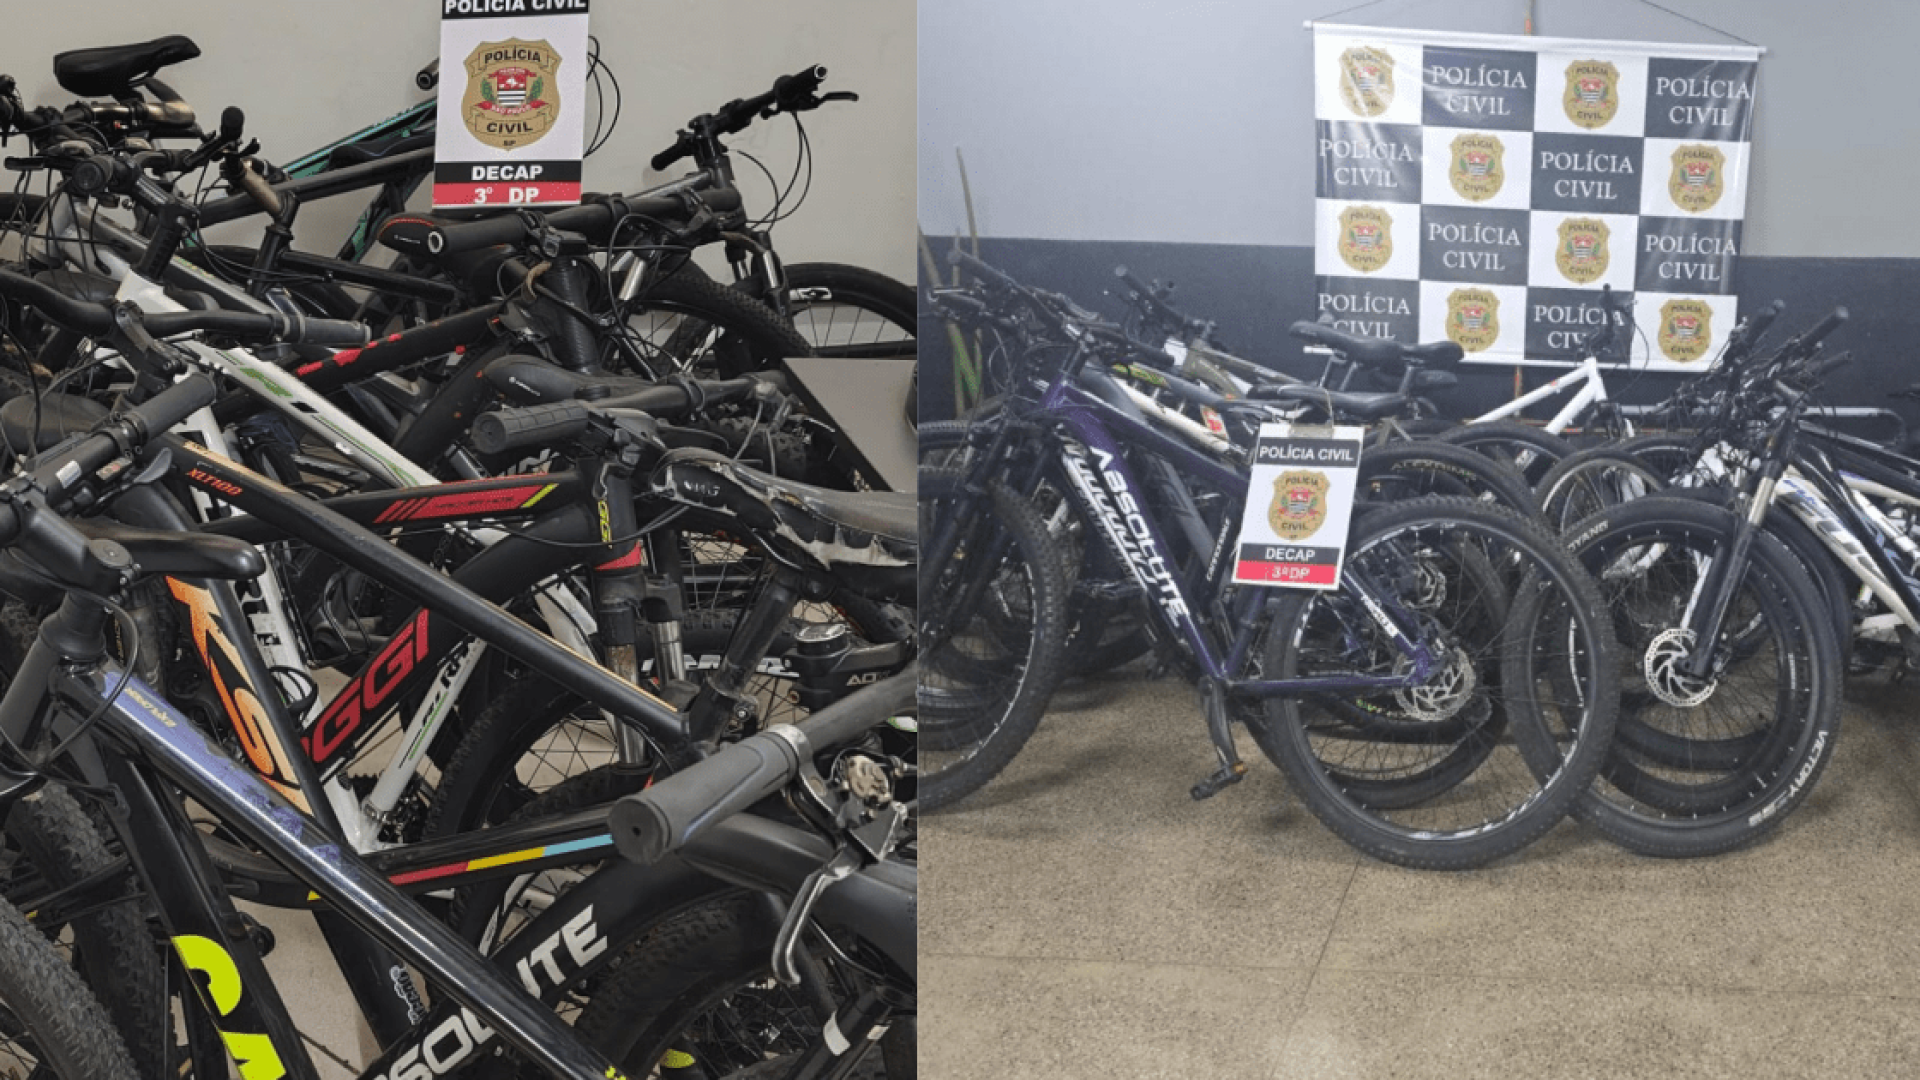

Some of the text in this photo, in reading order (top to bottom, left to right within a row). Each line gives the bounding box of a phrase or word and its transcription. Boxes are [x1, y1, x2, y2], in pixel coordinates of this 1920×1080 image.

[484, 45, 541, 63] POLÍCIA
[1431, 64, 1527, 89] POLÍCIA
[1656, 75, 1750, 99] POLÍCIA
[1447, 95, 1511, 115] CIVIL
[1669, 106, 1733, 126] CIVIL
[486, 122, 533, 134] CIVIL
[1319, 138, 1414, 162] POLÍCIA
[1540, 149, 1634, 174] POLÍCIA
[471, 165, 543, 181] DECAP
[1334, 167, 1398, 187] CIVIL
[509, 187, 540, 204] DP
[1554, 179, 1617, 199] CIVIL
[1428, 222, 1522, 246] POLÍCIA
[1645, 233, 1736, 256] POLÍCIA
[1443, 251, 1505, 271] CIVIL
[1658, 262, 1720, 281] CIVIL
[1318, 292, 1411, 315] POLÍCIA
[1259, 444, 1354, 461] POLÍCIA CIVIL
[1281, 522, 1308, 531] CIVIL
[1089, 446, 1190, 628] ABSOLUTE
[1265, 547, 1315, 561] DECAP
[300, 608, 429, 762] GGI
